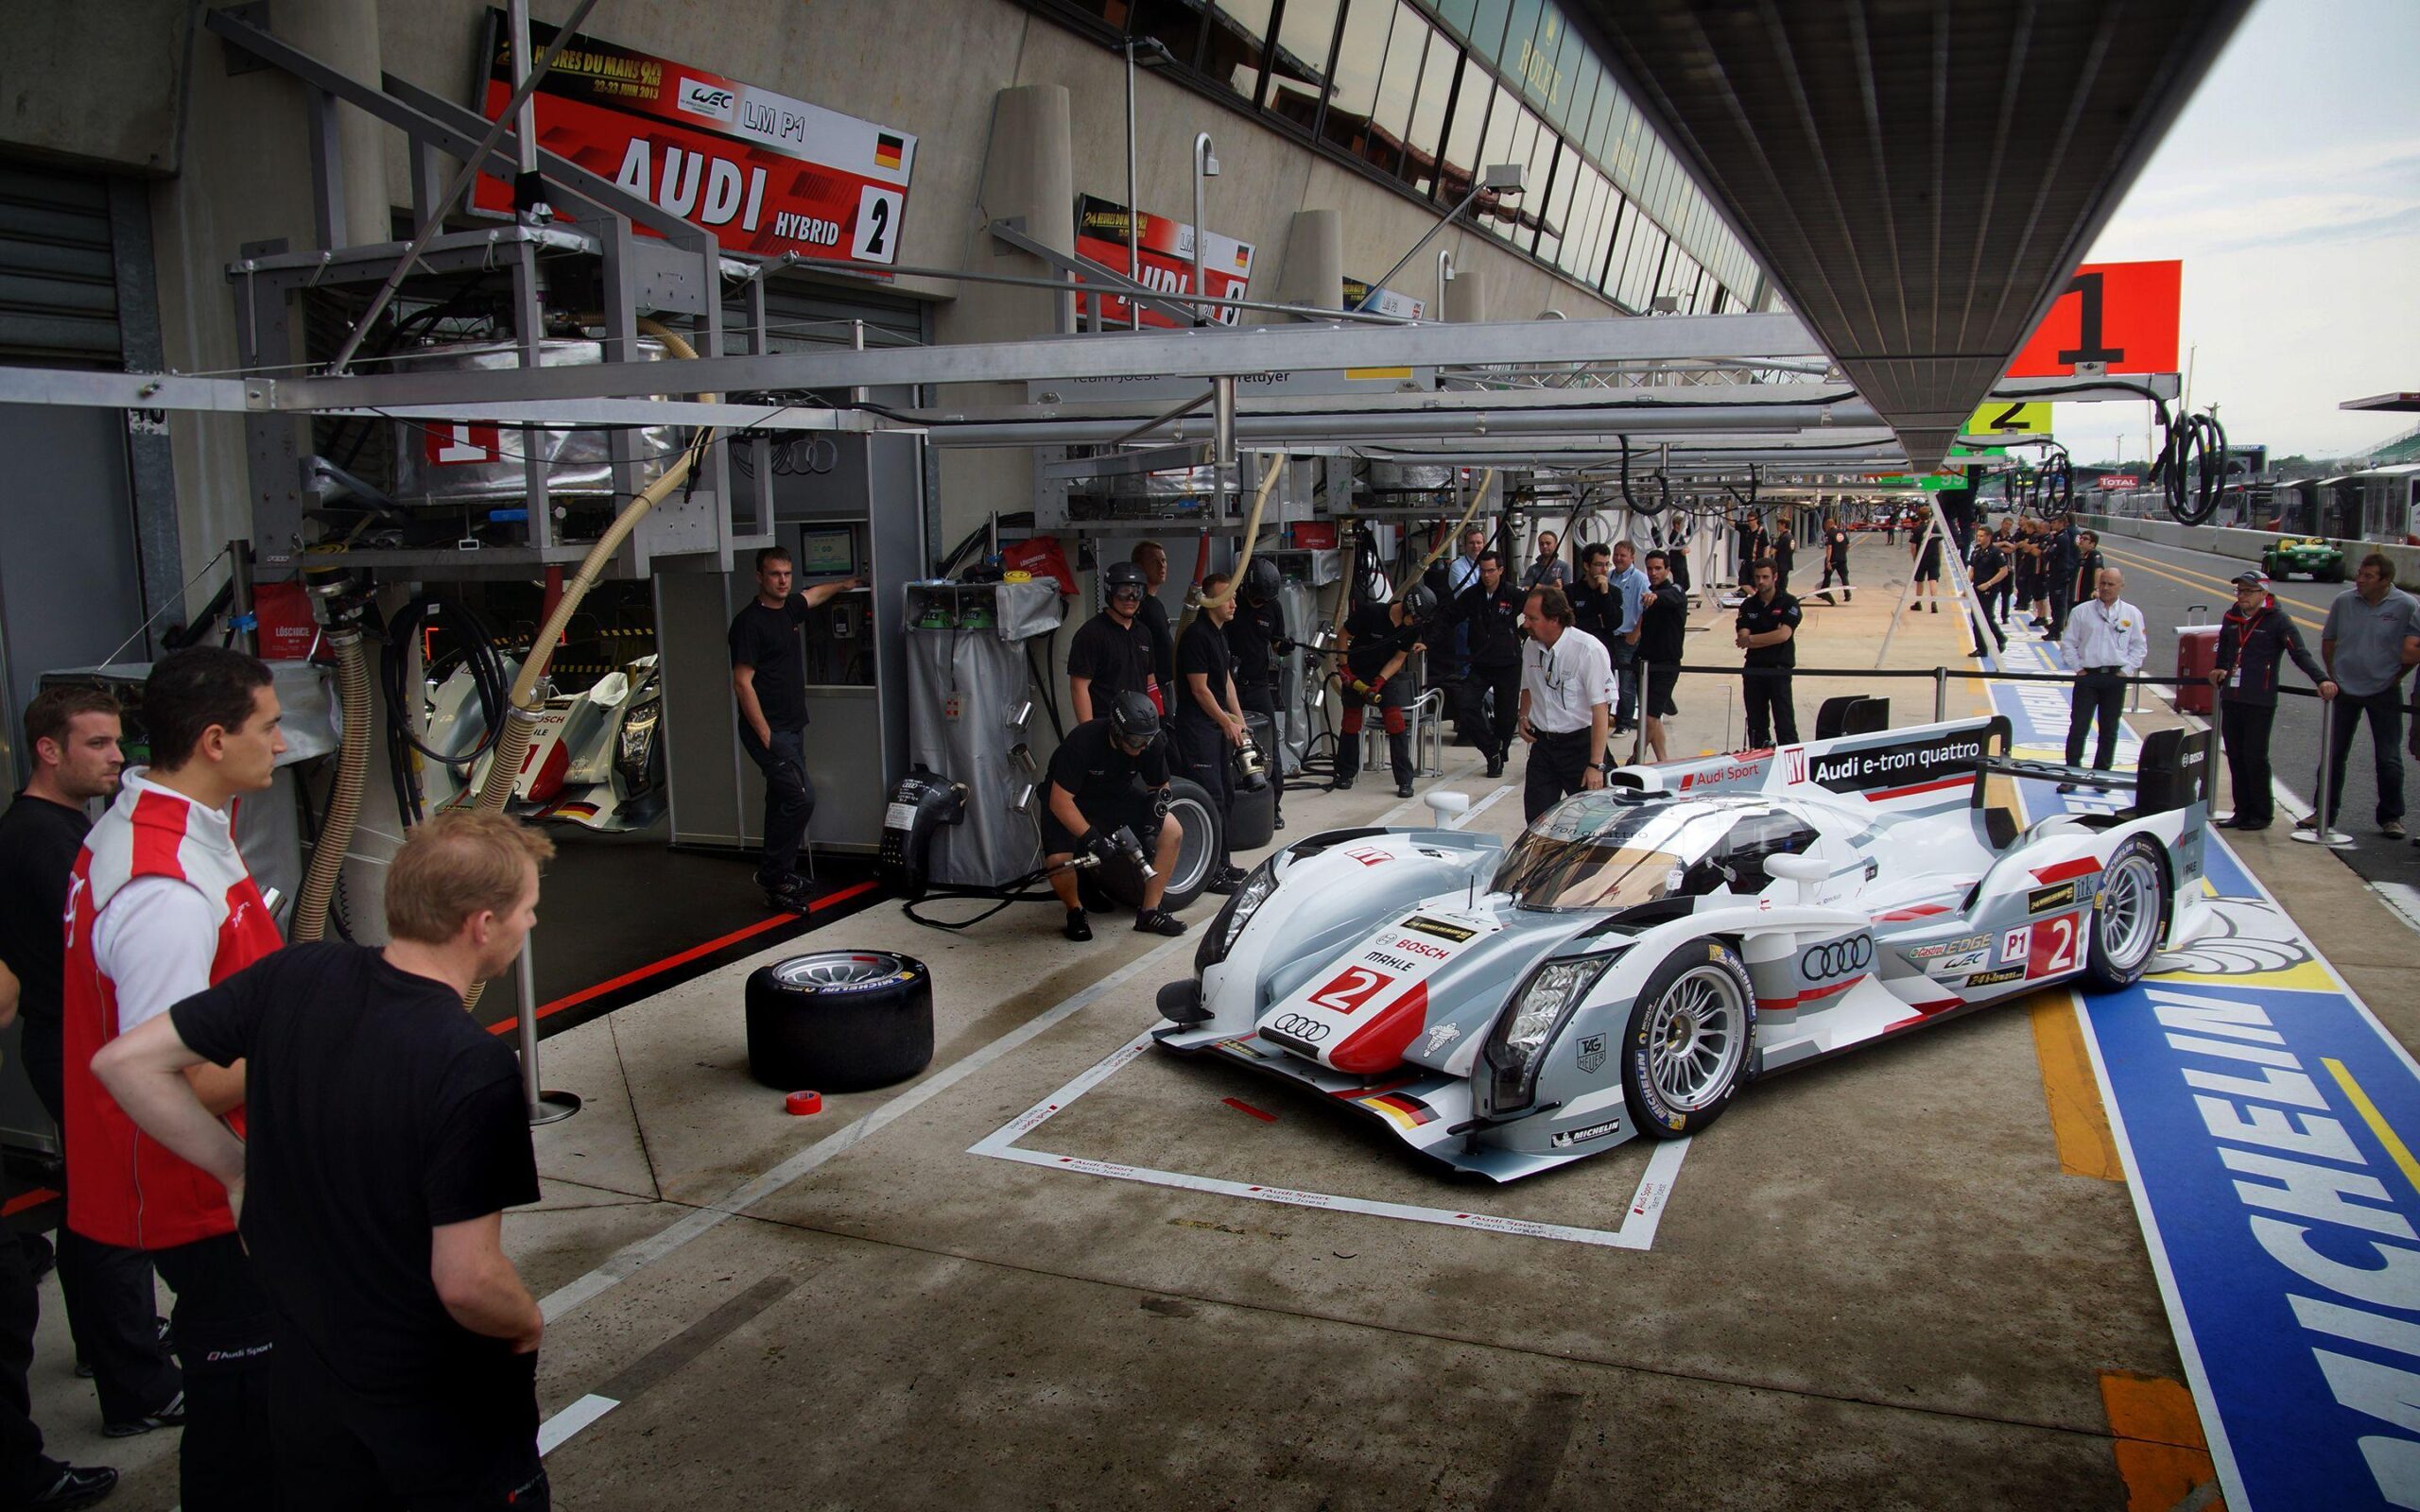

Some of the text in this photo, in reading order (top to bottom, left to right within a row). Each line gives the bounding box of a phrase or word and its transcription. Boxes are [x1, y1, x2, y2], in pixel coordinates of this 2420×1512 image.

[583, 53, 603, 73] DU
[604, 56, 641, 78] MANS
[1518, 39, 1563, 106] ROLEX
[639, 85, 659, 100] 2013
[691, 88, 733, 109] WEC
[744, 101, 775, 134] LM
[781, 112, 805, 141] P1
[614, 137, 767, 232] AUDI
[774, 211, 839, 247] HYBRID
[864, 197, 889, 255] 2
[2058, 272, 2124, 365] 1
[2100, 477, 2135, 487] TOTAL
[1785, 743, 1979, 784] HY Audi e-tron quattro
[2189, 750, 2204, 764] BOSCH
[1697, 764, 1759, 785] Audi Sport
[1395, 939, 1450, 959] BOSCH
[1918, 933, 1993, 957] Castrol EDGE
[2006, 919, 2071, 971] P1 2
[1364, 952, 1415, 971] MAHLE
[1944, 953, 1984, 969] WEC
[822, 979, 894, 992] MICHELIN
[1318, 970, 1377, 1012] 2
[1728, 955, 1756, 1016] MICHELIN
[1582, 1038, 1601, 1054] TAG
[1579, 1053, 1605, 1070] HEUER
[1636, 1051, 1667, 1120] MICHELIN
[1574, 1121, 1619, 1140] MICHELIN
[1070, 1164, 1132, 1177] Team Joest
[1073, 1160, 1134, 1172] Audi Sport
[1295, 1193, 1331, 1201] Sport
[1635, 1183, 1653, 1208] Audi Sport
[1654, 1183, 1668, 1196] Joest
[1261, 1193, 1328, 1206] Team Joest
[1470, 1220, 1505, 1229] Team
[1473, 1215, 1544, 1229] Audi Sport
[220, 1349, 245, 1360] Audi
